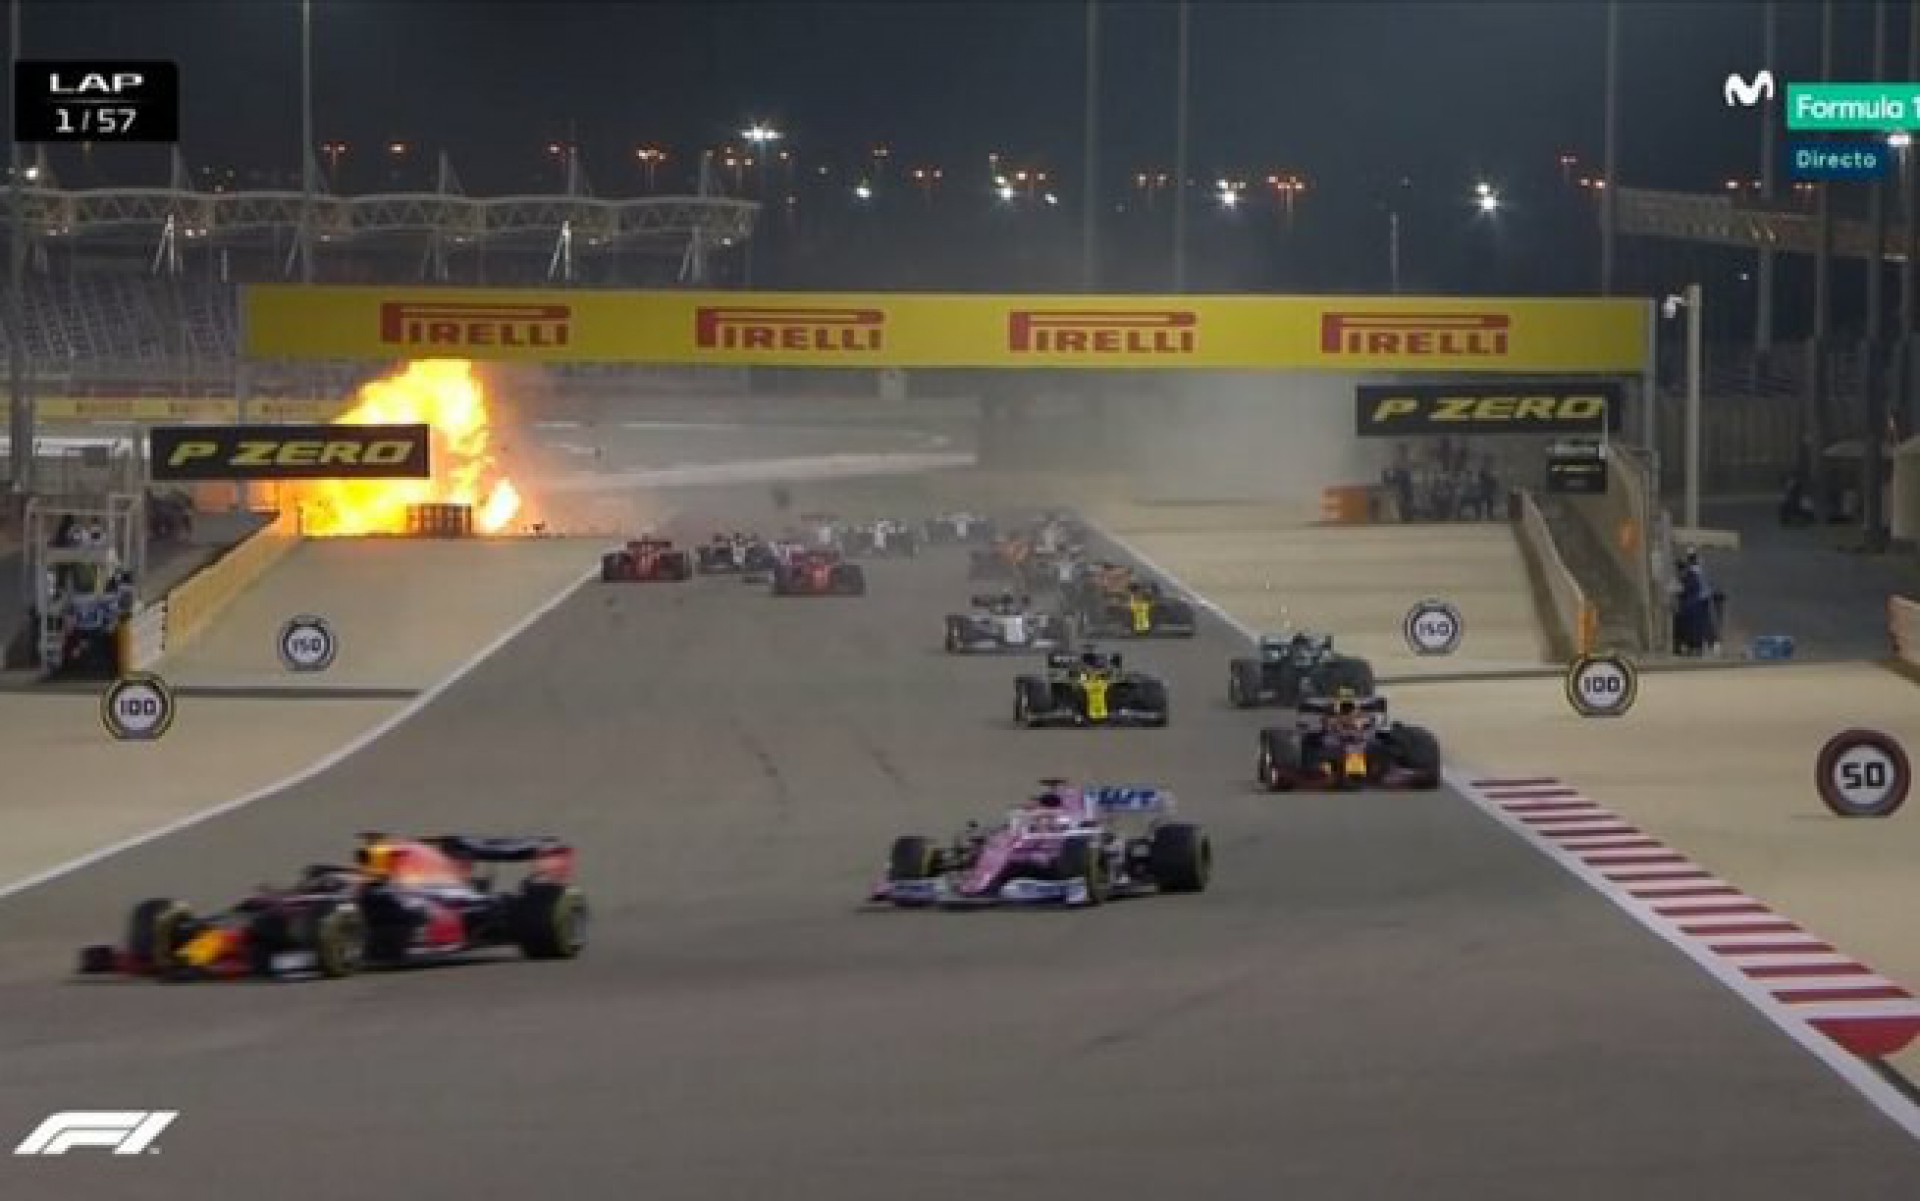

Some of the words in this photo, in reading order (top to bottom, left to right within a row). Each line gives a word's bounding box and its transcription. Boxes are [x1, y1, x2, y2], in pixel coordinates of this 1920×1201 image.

[380, 302, 571, 347] PIRELLI
[695, 306, 885, 352] PIRELLI
[1009, 311, 1197, 354] PIRELLI
[1321, 312, 1510, 355] PIRELLI
[1371, 399, 1416, 422] P
[1428, 396, 1604, 421] ZERO
[167, 441, 219, 466] P
[227, 440, 414, 466] ZERO
[1583, 676, 1621, 693] 100
[120, 698, 157, 716] 100
[1842, 762, 1885, 789] 50
